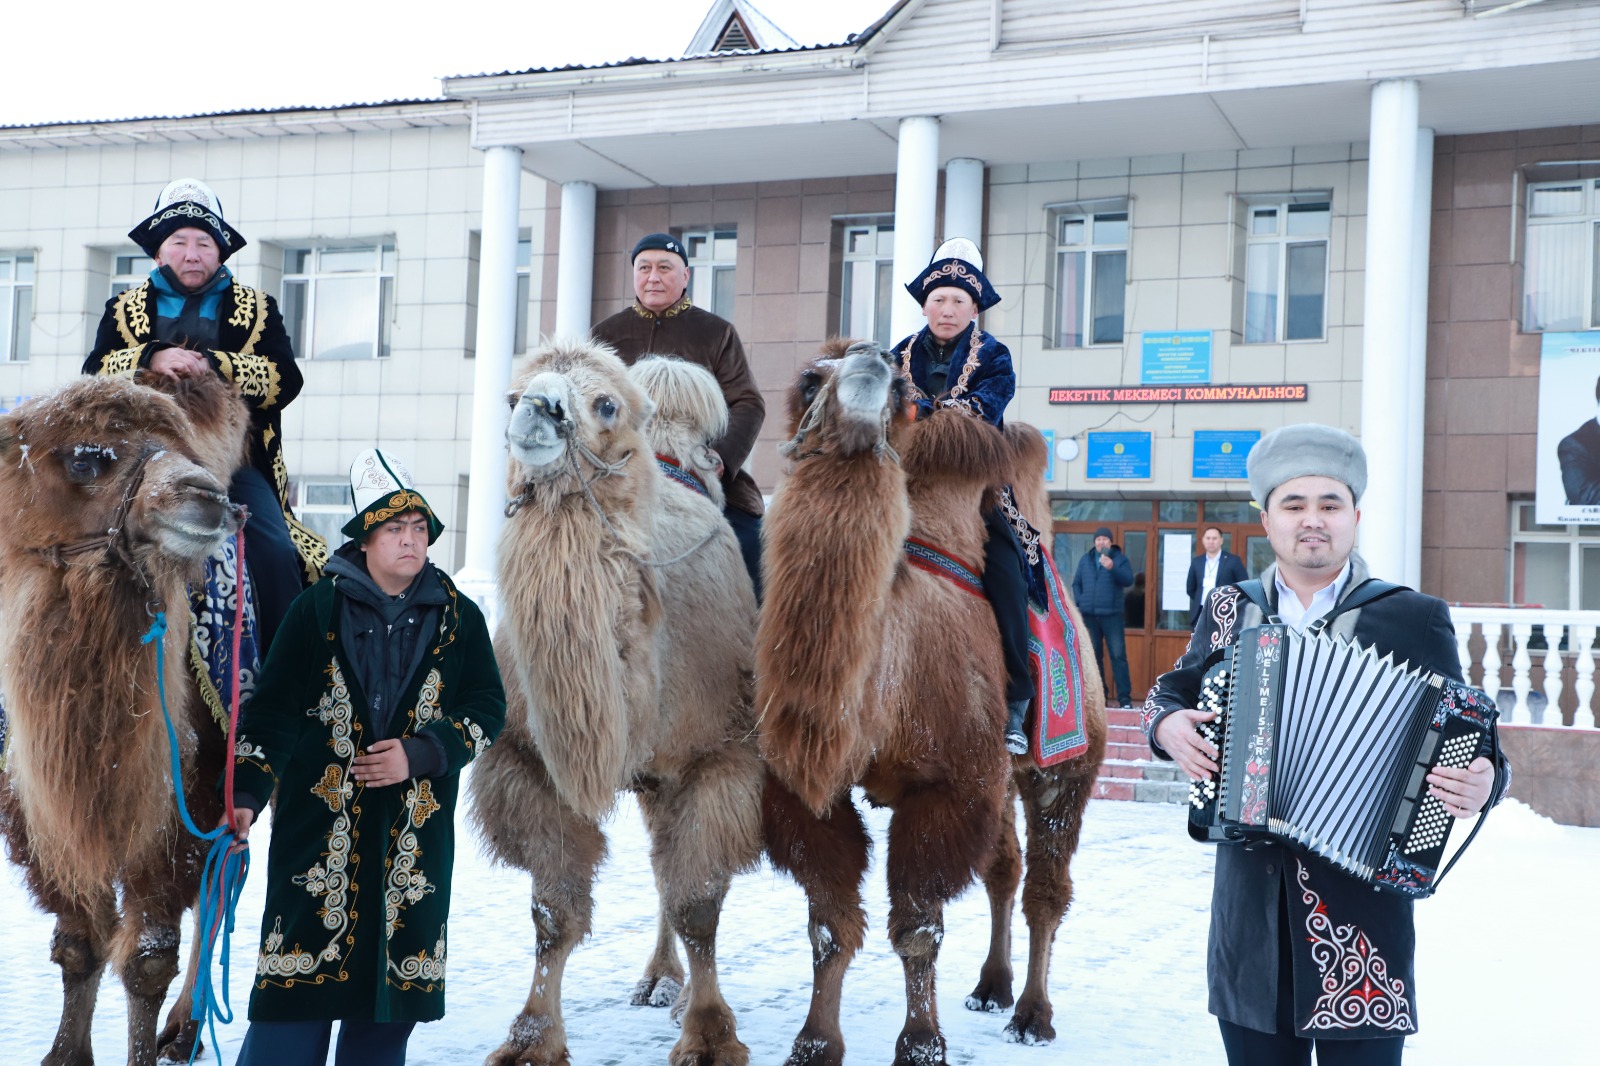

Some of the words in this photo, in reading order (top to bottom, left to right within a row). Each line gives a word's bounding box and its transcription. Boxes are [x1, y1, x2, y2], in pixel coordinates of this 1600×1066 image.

[1113, 388, 1182, 401] МЕКЕМЕСІ
[1185, 386, 1305, 400] КОММУНАЛЬНОЕ
[1255, 646, 1275, 756] WELTMEISTER
